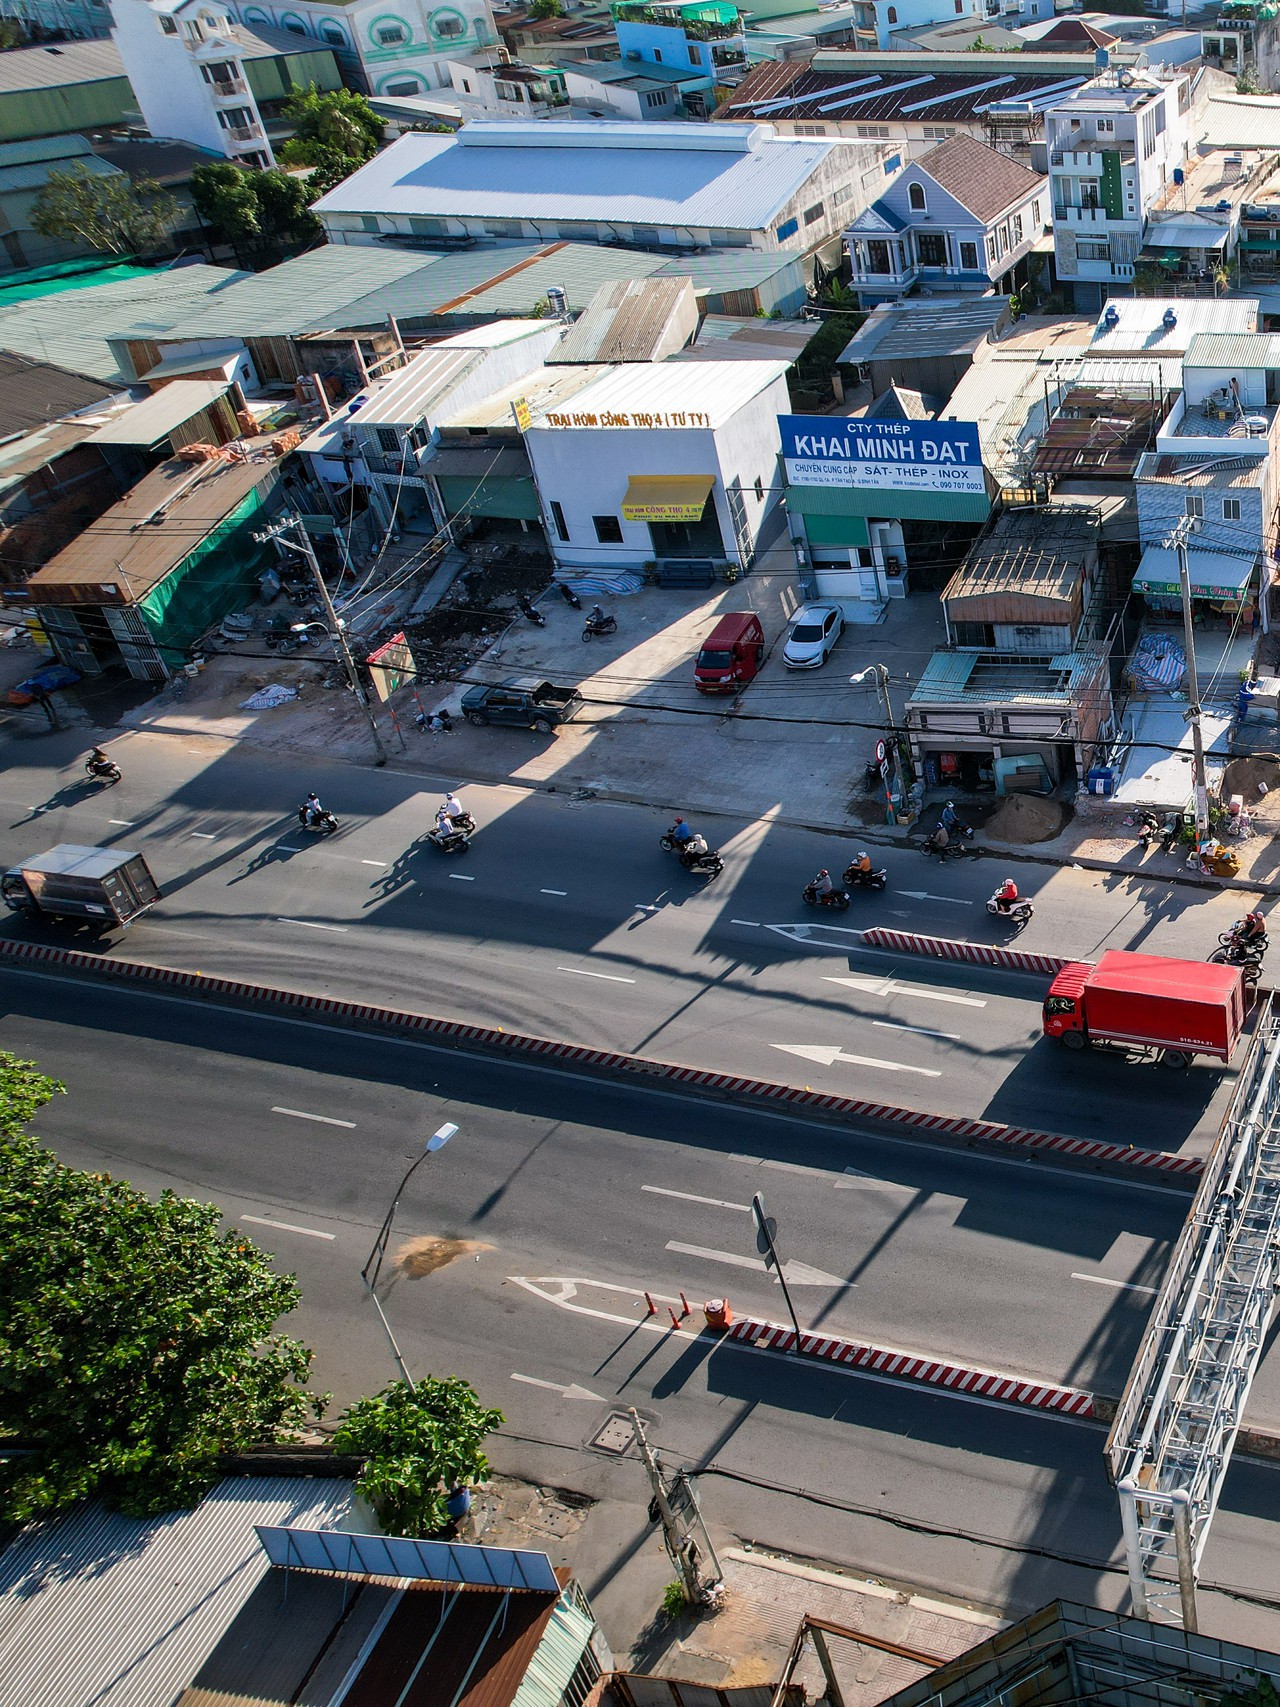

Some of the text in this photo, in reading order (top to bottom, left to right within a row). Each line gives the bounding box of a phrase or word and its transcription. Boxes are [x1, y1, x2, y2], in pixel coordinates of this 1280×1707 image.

[847, 422, 911, 435] CTY THÉP
[794, 435, 970, 466] KHAI MINH ĐẠT
[822, 465, 842, 474] CUNG
[895, 466, 928, 478] THÉP
[939, 469, 969, 479] INOX
[940, 481, 952, 489] 090
[953, 482, 964, 490] 707
